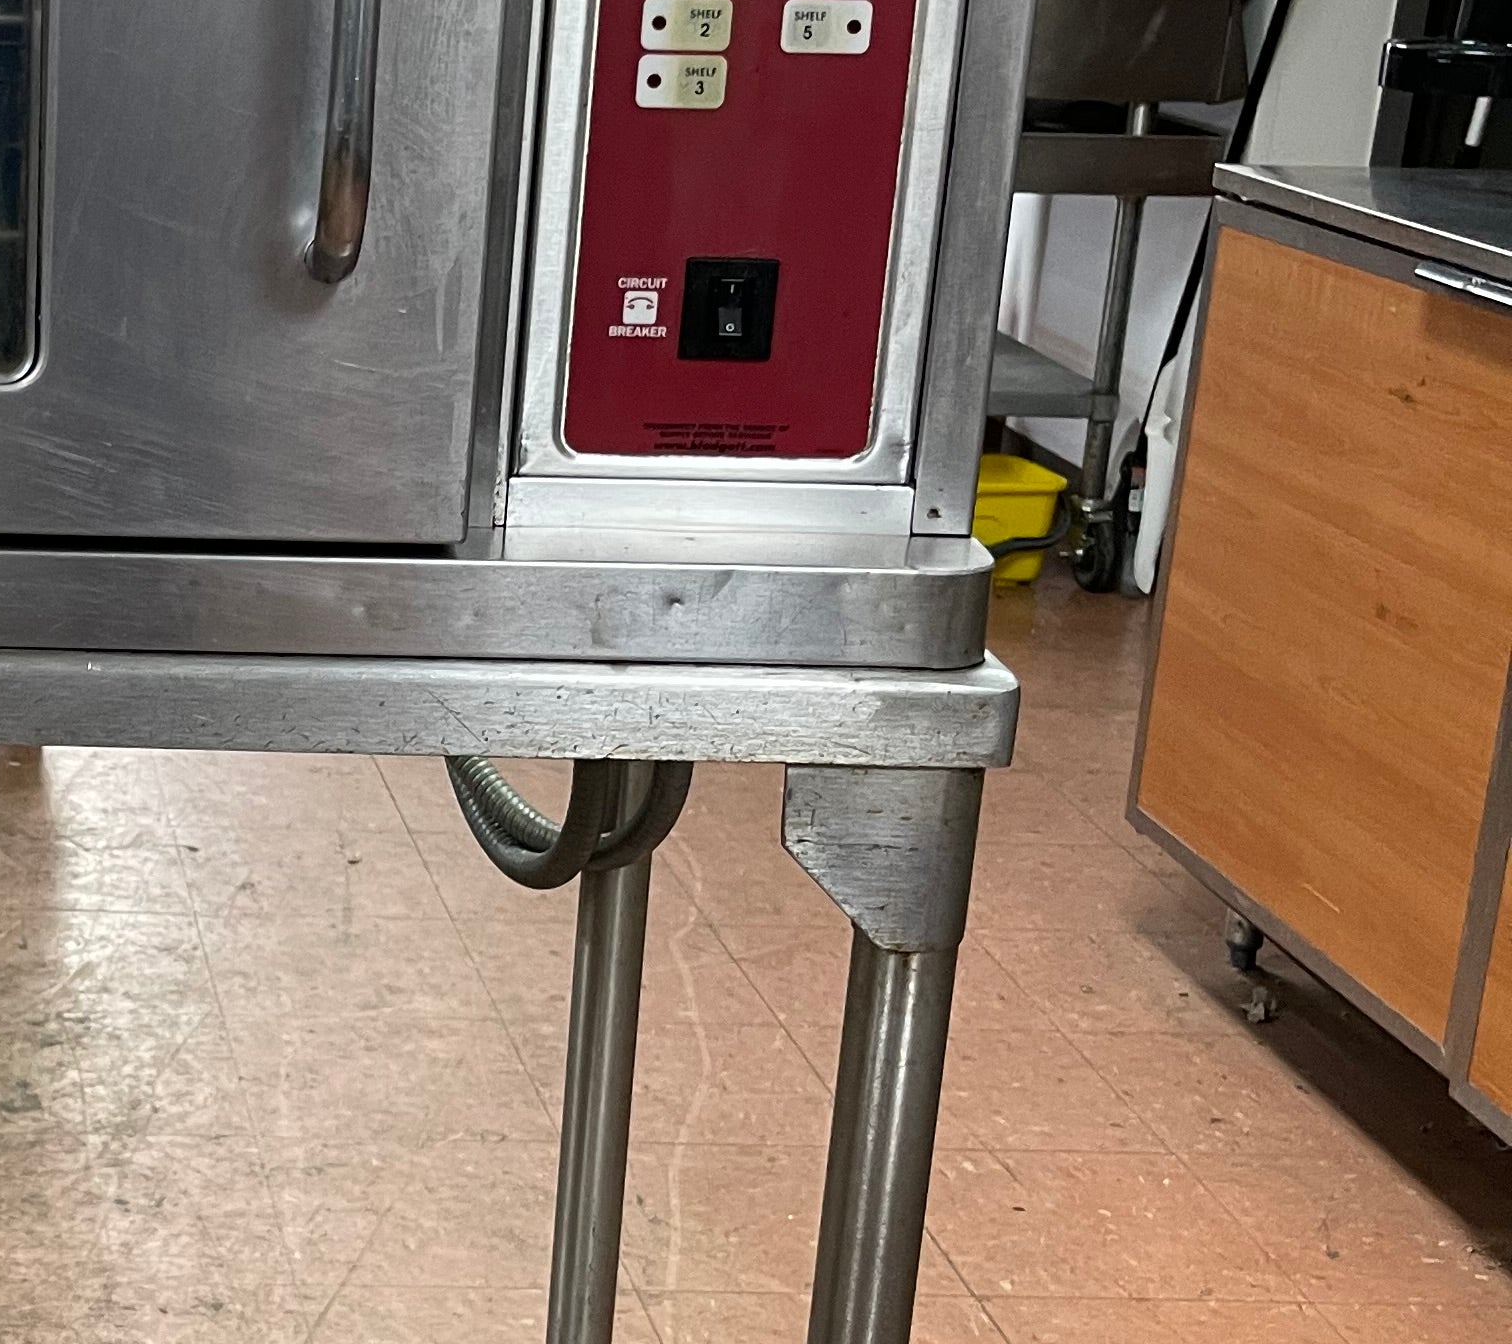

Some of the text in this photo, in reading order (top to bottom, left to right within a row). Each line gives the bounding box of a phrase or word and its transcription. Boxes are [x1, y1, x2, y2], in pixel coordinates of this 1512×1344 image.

[689, 9, 723, 20] SHELF
[793, 11, 828, 22] SHELF
[699, 22, 711, 38] 2
[801, 25, 813, 41] 5
[684, 67, 718, 78] SHELF
[693, 80, 705, 96] 3
[617, 277, 668, 290] CIRCUIT
[608, 325, 667, 338] BREAKER
